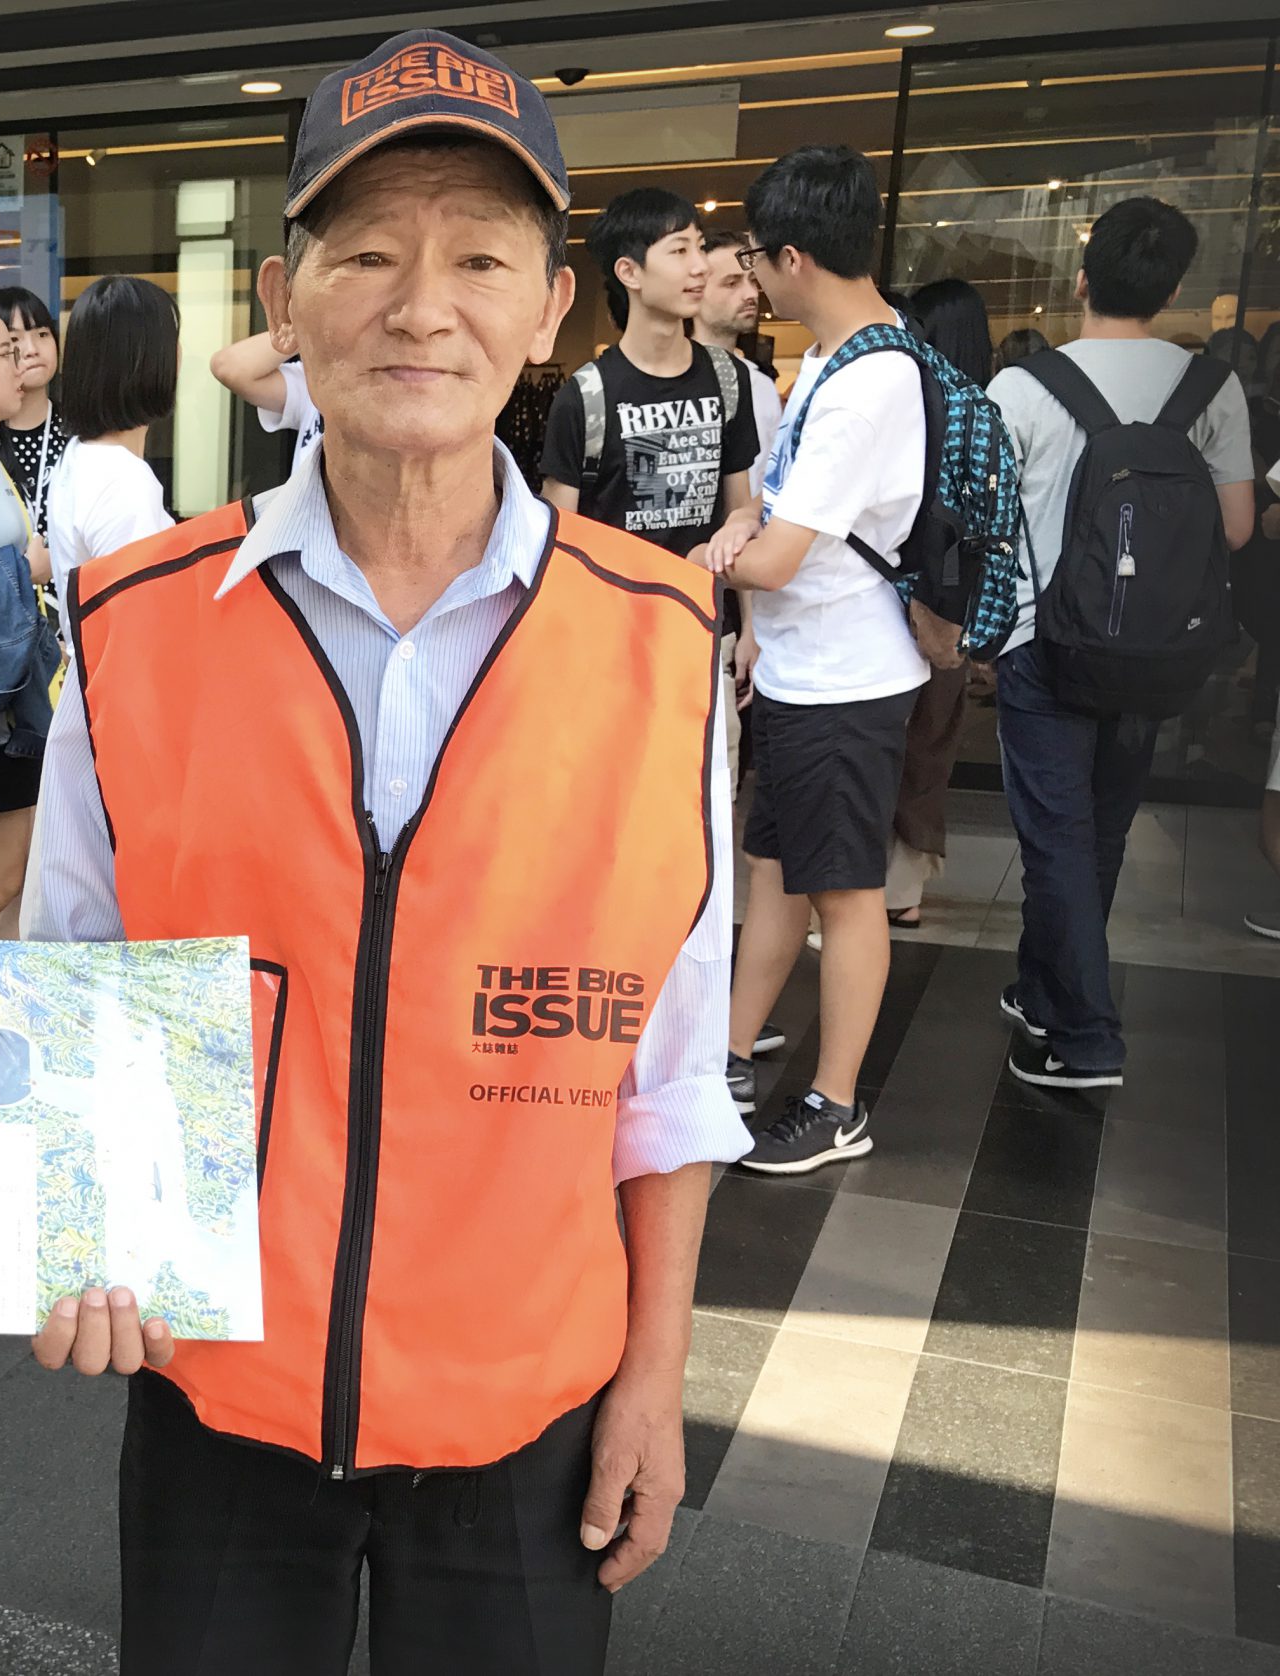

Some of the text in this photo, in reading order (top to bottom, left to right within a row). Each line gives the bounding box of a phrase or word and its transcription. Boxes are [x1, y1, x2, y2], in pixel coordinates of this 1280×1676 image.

[355, 50, 504, 87] THE BIG
[352, 68, 510, 113] ISSUE
[619, 396, 721, 436] RBVAE
[658, 450, 693, 466] Enw
[666, 471, 689, 487] Of
[477, 964, 645, 997] THE BIG
[472, 992, 644, 1044] ISSUE
[469, 1084, 564, 1105] OFFICIAL
